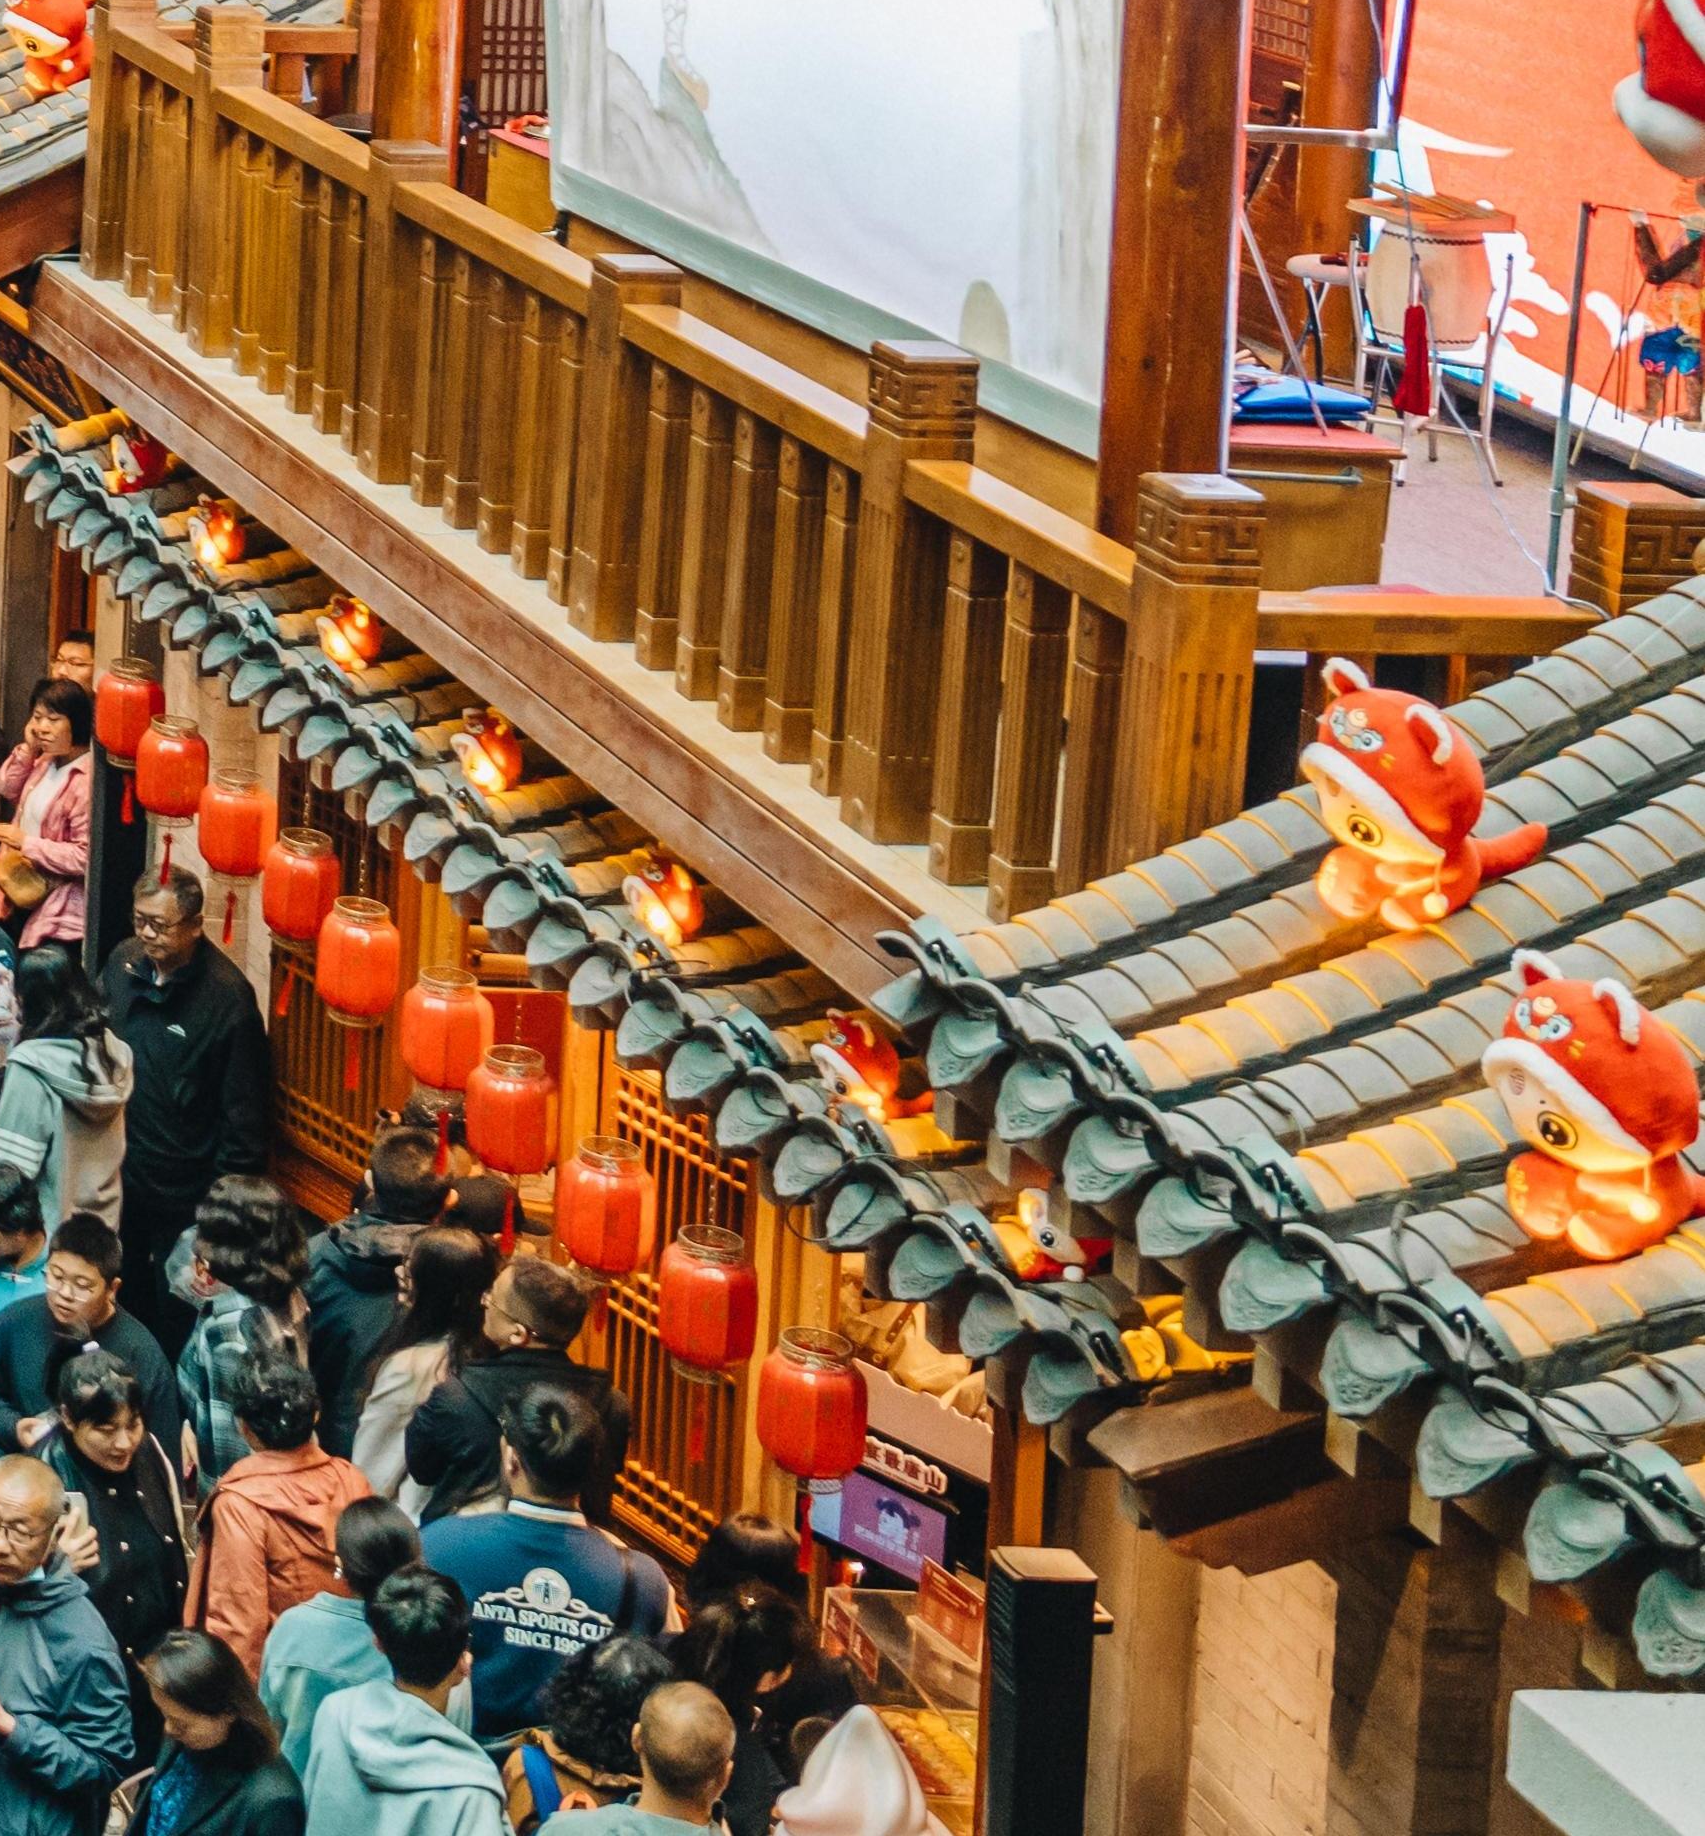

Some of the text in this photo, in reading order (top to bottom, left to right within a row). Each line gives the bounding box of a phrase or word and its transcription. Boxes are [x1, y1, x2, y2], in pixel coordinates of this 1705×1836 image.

[472, 1601, 516, 1624] ANTA
[518, 1609, 580, 1639] SPORTS
[504, 1626, 551, 1650] SINCE
